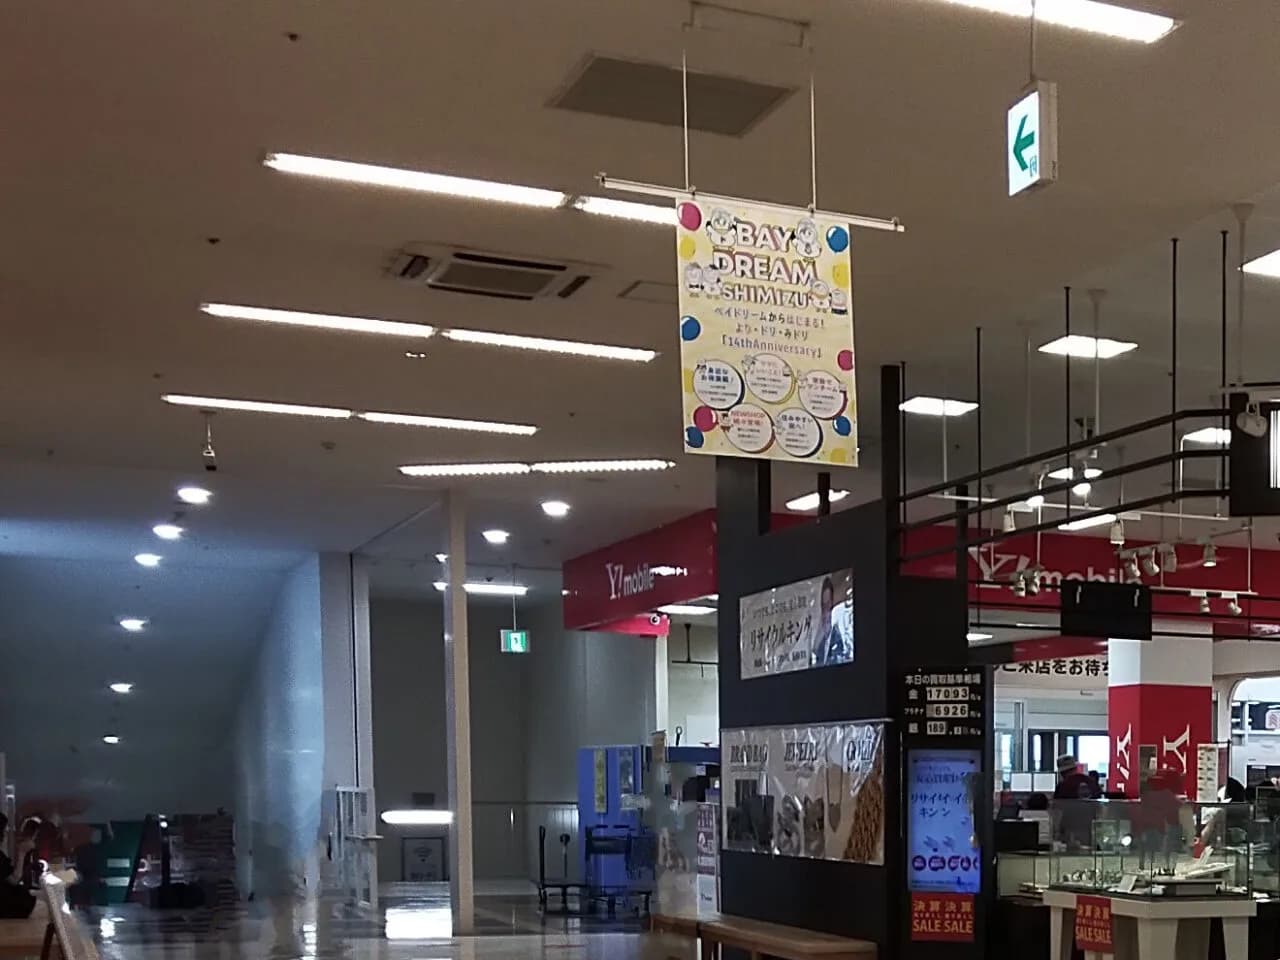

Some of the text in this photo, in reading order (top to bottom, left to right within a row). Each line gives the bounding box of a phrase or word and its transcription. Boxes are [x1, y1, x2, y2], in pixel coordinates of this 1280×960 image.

[736, 221, 795, 252] BAY
[713, 249, 815, 286] DREAM
[721, 283, 811, 309] SHIMIZU
[927, 688, 968, 699] 17093
[913, 920, 973, 933] SALE SALE
